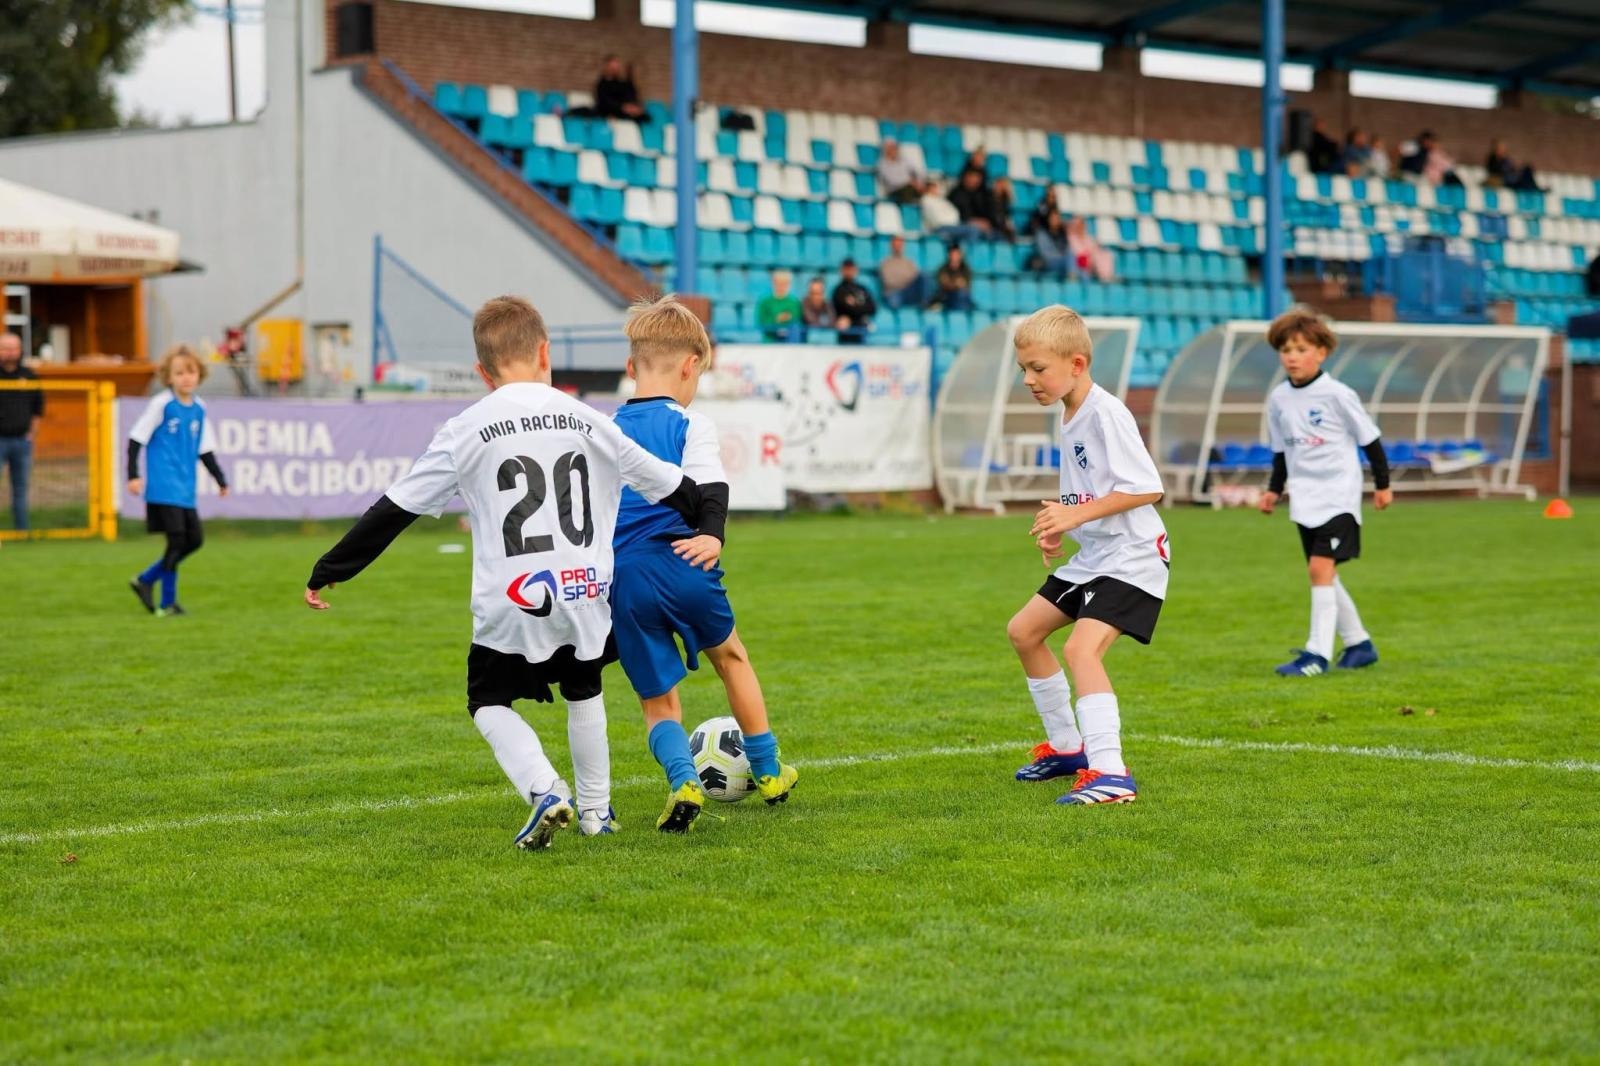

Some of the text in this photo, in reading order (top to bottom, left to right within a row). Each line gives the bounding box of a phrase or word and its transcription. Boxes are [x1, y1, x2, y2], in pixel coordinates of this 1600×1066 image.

[212, 418, 334, 455] DEMIA
[479, 413, 594, 443] UNIA RACIBÓRZ
[496, 450, 595, 558] 20
[560, 567, 597, 585] PRO
[563, 581, 608, 601] SPORT
